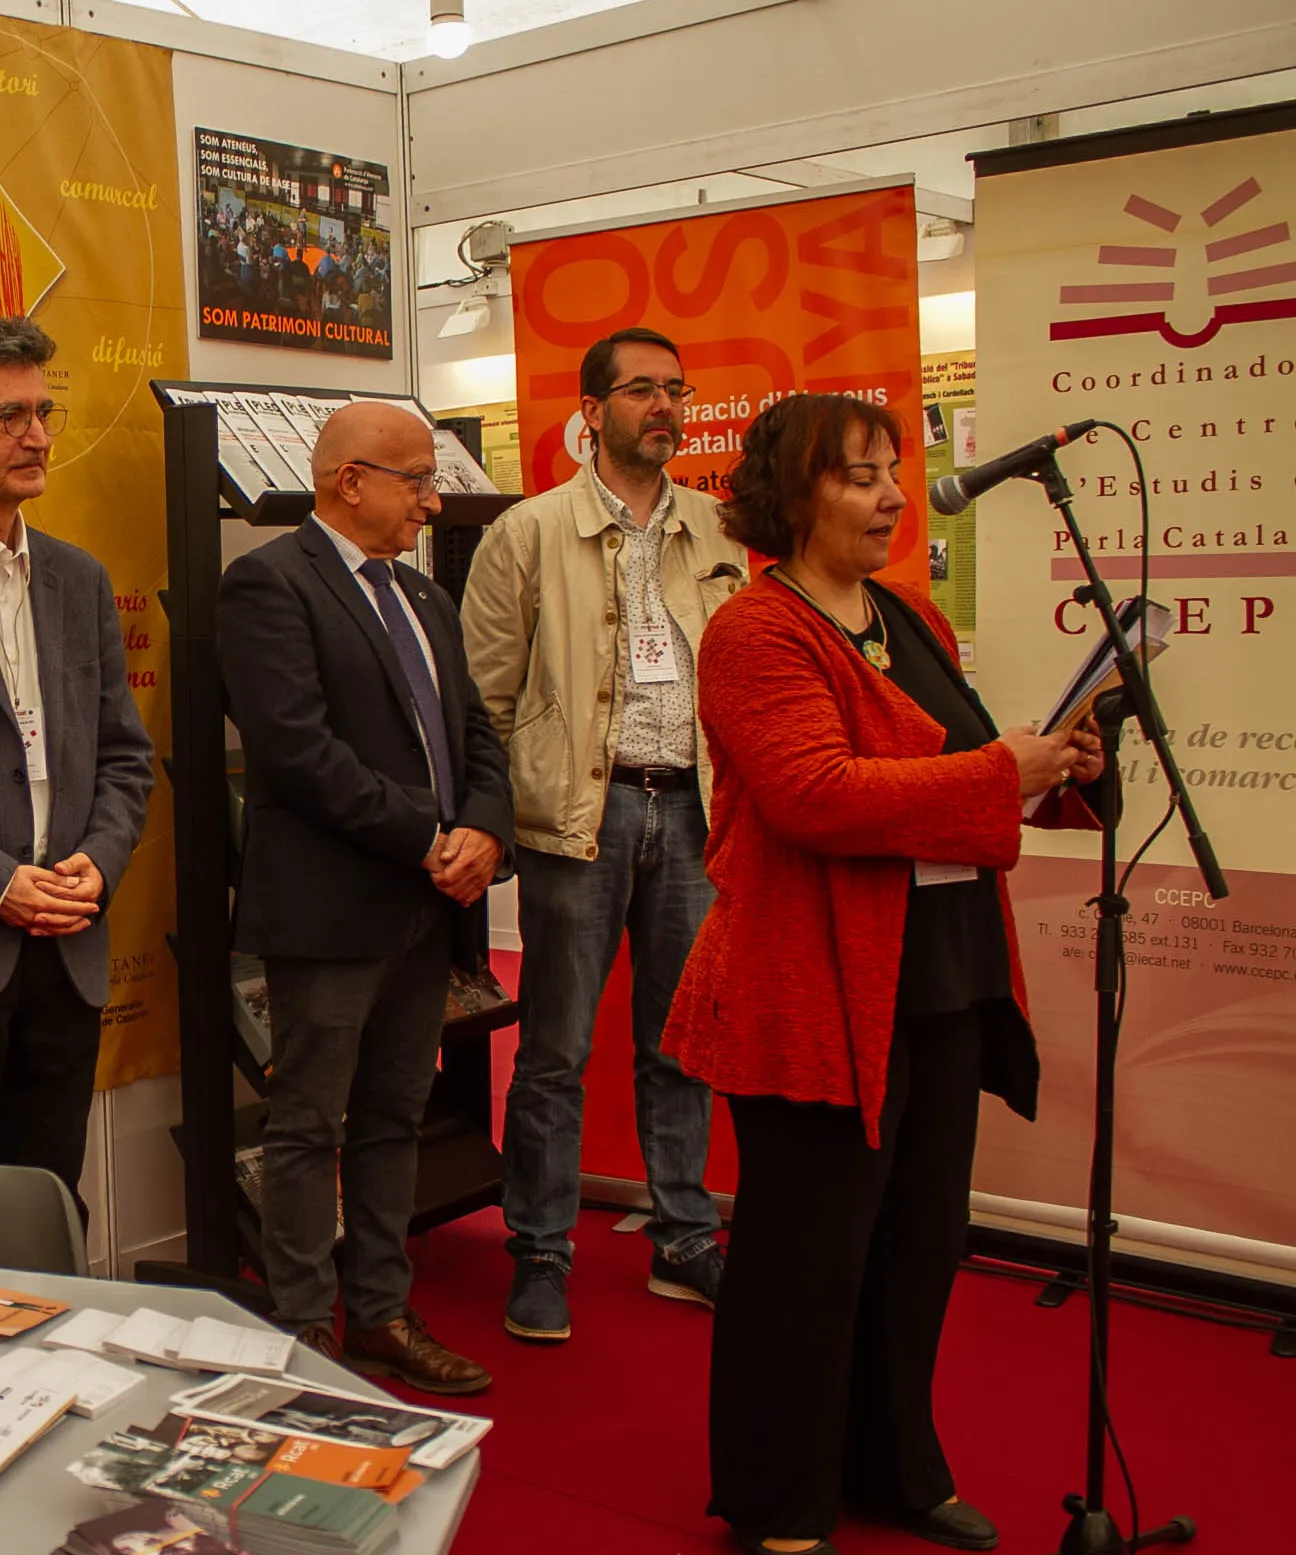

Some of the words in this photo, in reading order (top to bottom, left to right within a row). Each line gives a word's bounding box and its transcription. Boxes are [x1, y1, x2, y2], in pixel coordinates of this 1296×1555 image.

[200, 134, 219, 147] SOM
[222, 138, 258, 155] ATENEUS,
[201, 150, 219, 162] SOM
[222, 154, 268, 172] ESSENCIALS,
[201, 165, 220, 177] SOM
[222, 169, 258, 185] CULTURA
[260, 175, 271, 186] DE
[60, 178, 158, 210] comarcal
[203, 307, 238, 328] SOM
[243, 311, 321, 338] PATRIMONI
[325, 323, 391, 347] CULTURAL
[92, 336, 164, 371] difusió
[43, 370, 70, 379] TANER
[937, 363, 948, 372] del
[1052, 355, 1295, 393] Coordinado
[682, 396, 750, 424] eració
[677, 428, 746, 456] Catalu
[1132, 417, 1296, 442] Centr
[1080, 469, 1263, 498] 'Estudis
[1163, 524, 1288, 548] Catala
[1054, 597, 1274, 635] CEP
[1187, 723, 1228, 748] de
[1239, 731, 1296, 751] rec
[1147, 760, 1159, 784] i
[1154, 888, 1217, 908] CCEPC
[1142, 913, 1159, 926] 47
[1181, 916, 1226, 932] 08001
[1232, 920, 1296, 938] Barcelona
[1061, 925, 1086, 938] 933
[1223, 941, 1244, 954] Fax
[1249, 943, 1278, 958] 932
